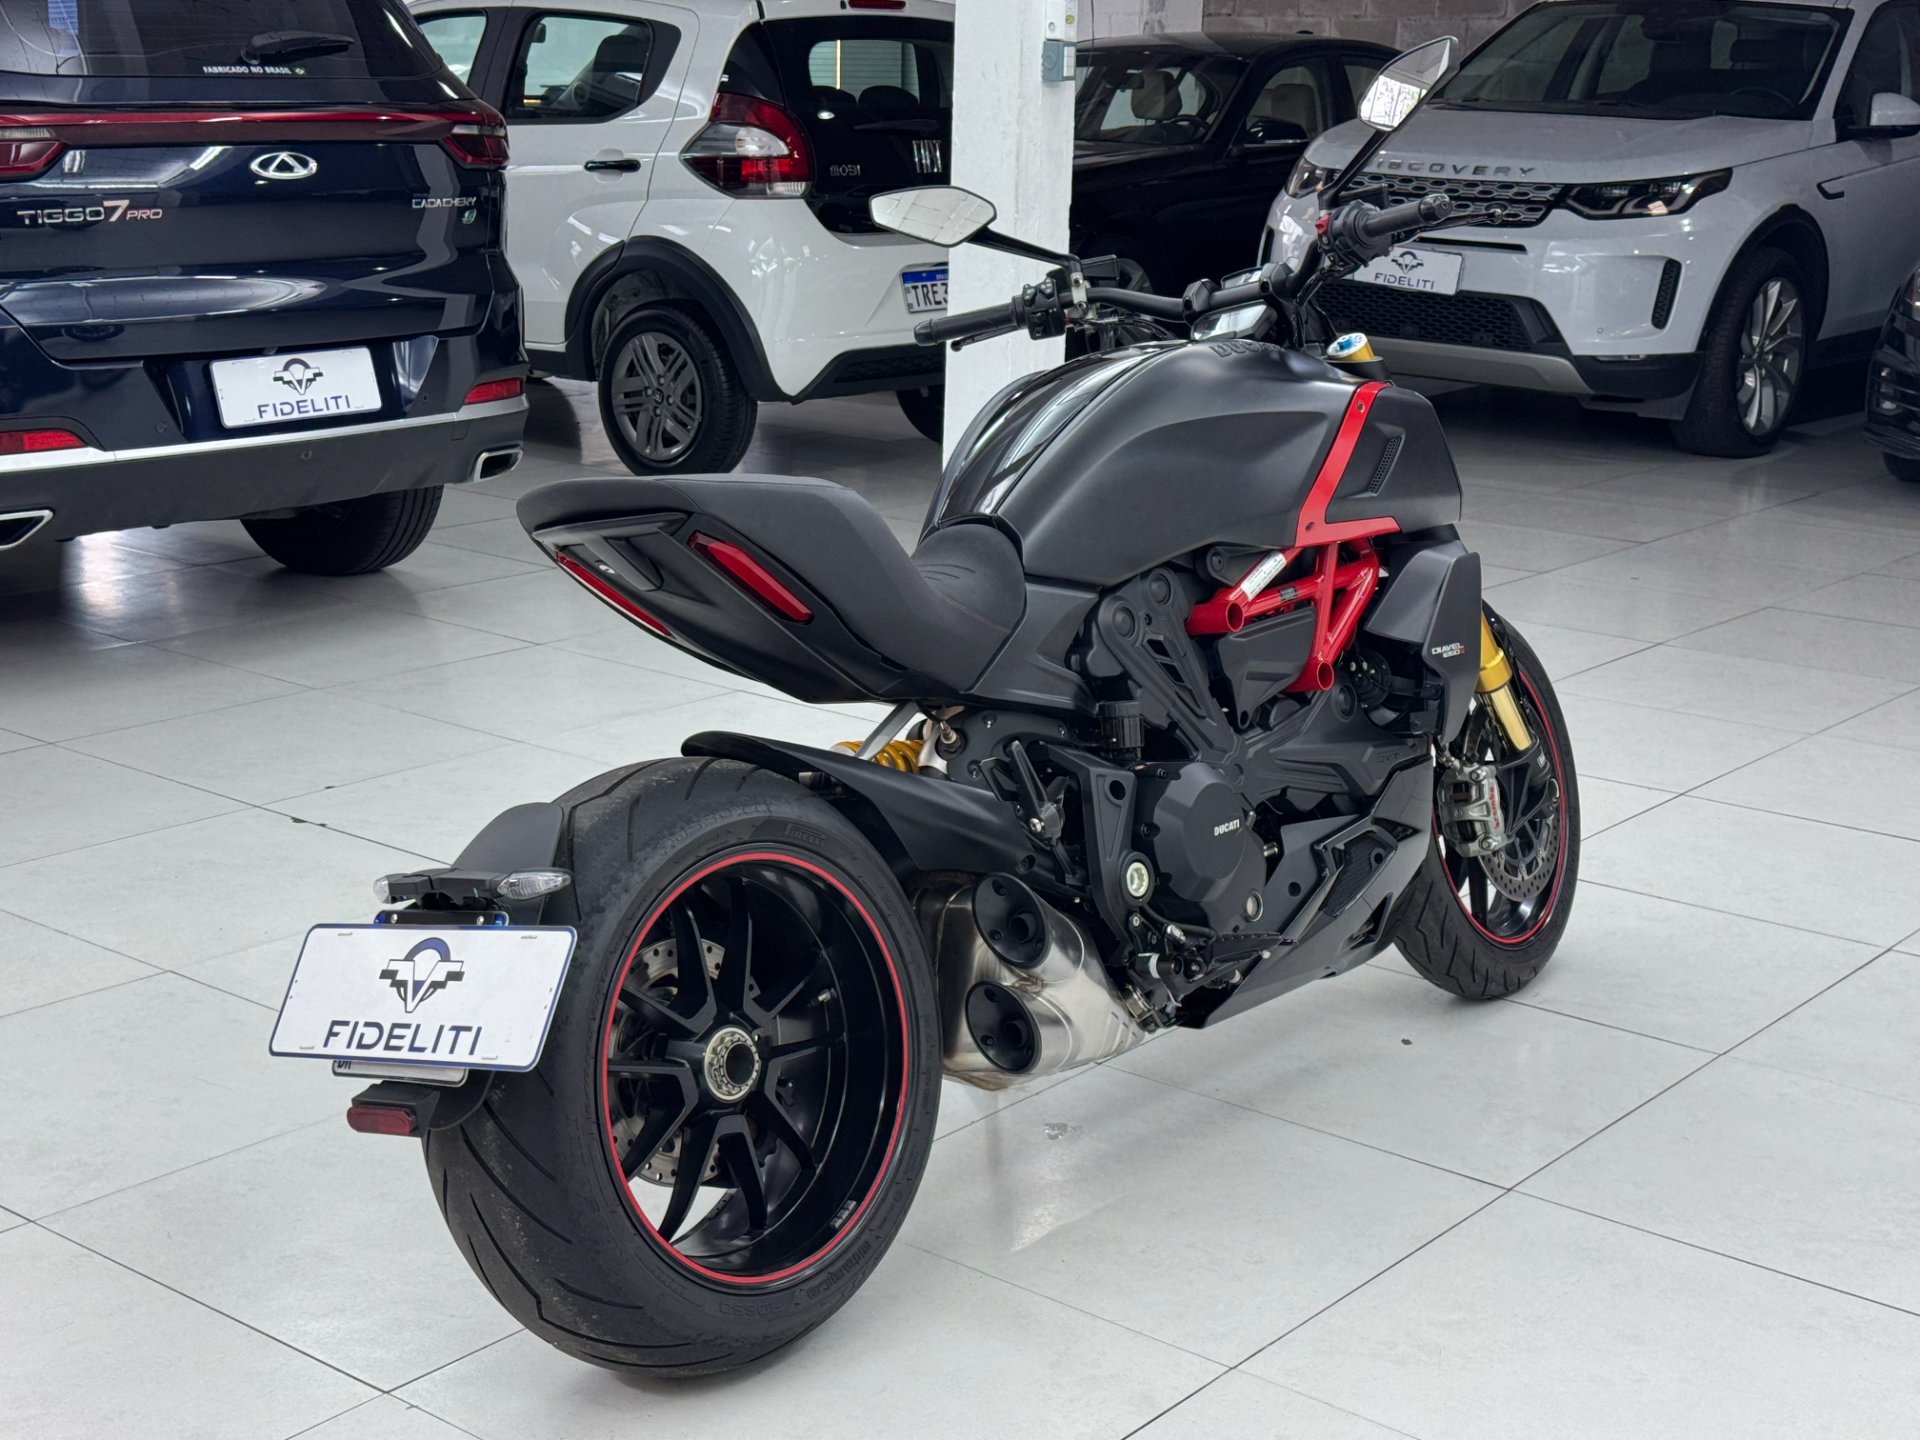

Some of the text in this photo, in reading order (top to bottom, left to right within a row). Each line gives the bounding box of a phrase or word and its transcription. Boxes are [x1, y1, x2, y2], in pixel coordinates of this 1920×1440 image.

[203, 66, 249, 74] FABRICADO
[265, 66, 292, 74] BRASIL
[830, 164, 861, 176] MOBI
[1372, 157, 1536, 177] ISCOVERY
[17, 206, 105, 225] TIGGO
[126, 208, 163, 220] PRO
[1375, 272, 1435, 290] FIDELITI
[257, 394, 350, 419] FIDELITI
[1214, 819, 1240, 836] DUCATI
[323, 1019, 482, 1056] FIDELITI
